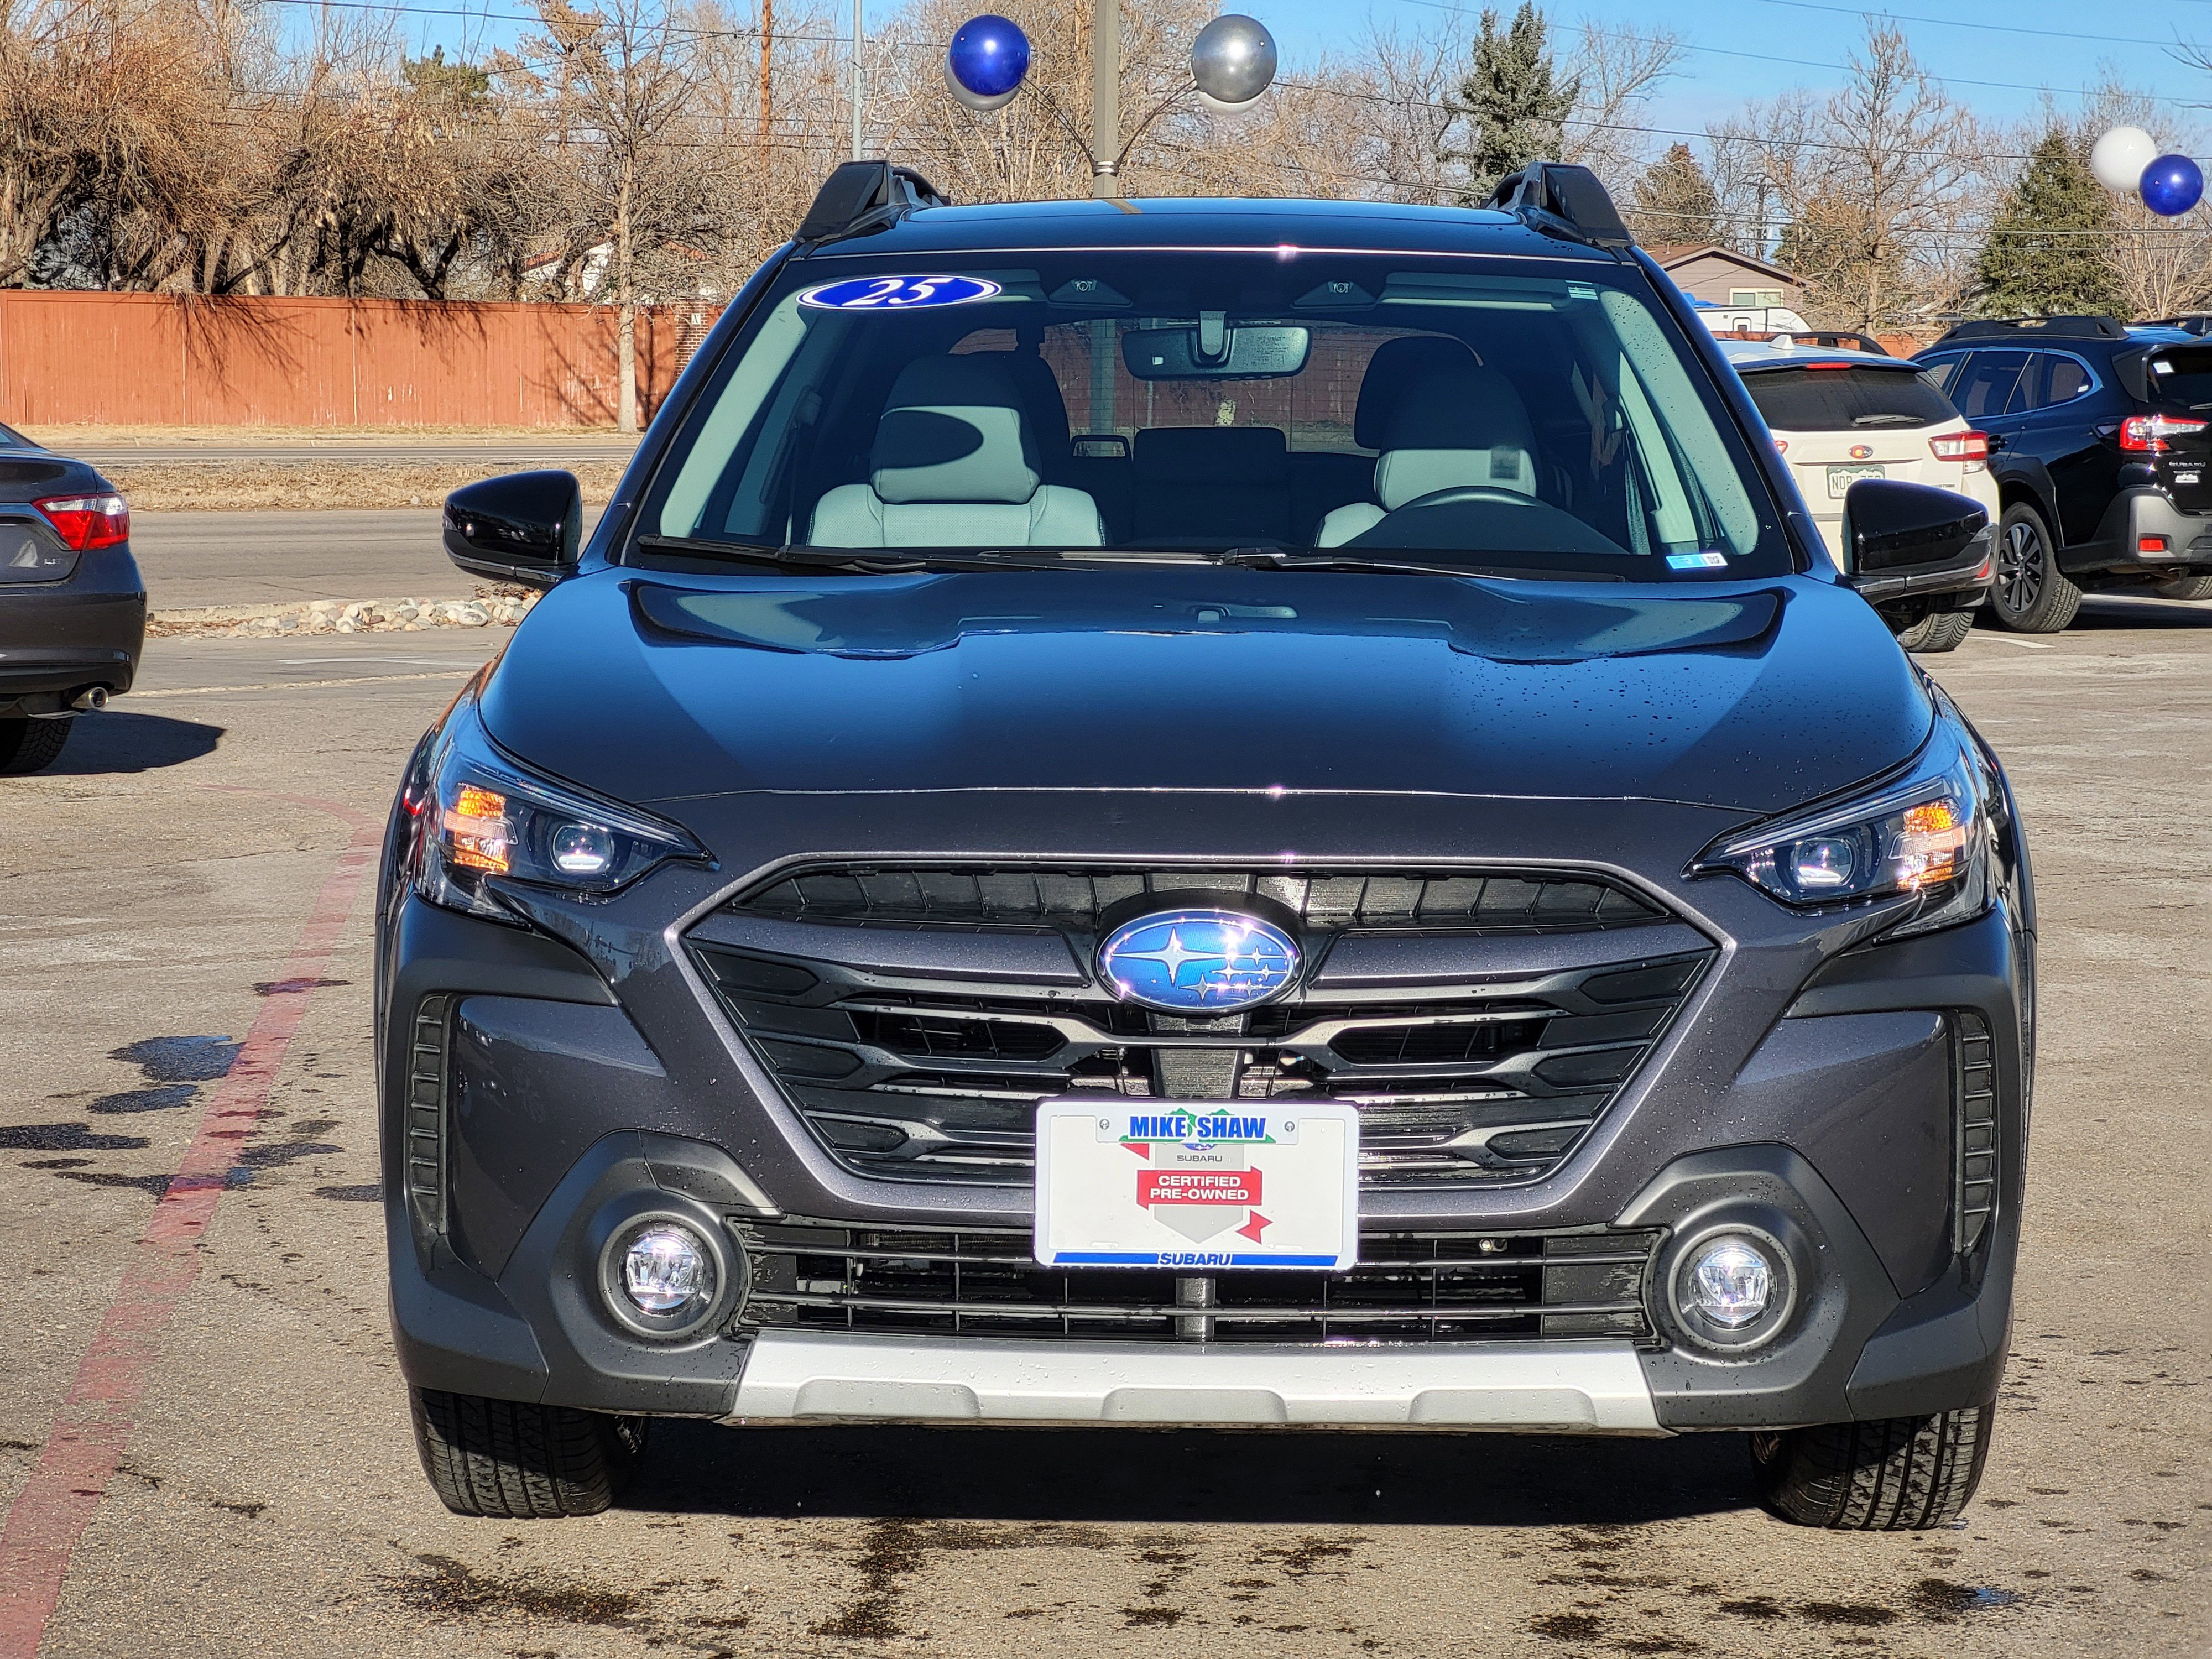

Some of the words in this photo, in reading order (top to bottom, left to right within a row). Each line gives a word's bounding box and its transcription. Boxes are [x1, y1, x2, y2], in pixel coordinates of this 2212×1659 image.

[841, 278, 954, 306] 25
[1130, 1116, 1186, 1137] MIKE
[1197, 1117, 1266, 1138] SHAW
[1158, 1175, 1241, 1187] CERTIFIED
[1150, 1188, 1249, 1200] PRE-OWNED
[1160, 1252, 1230, 1266] SUBARU
